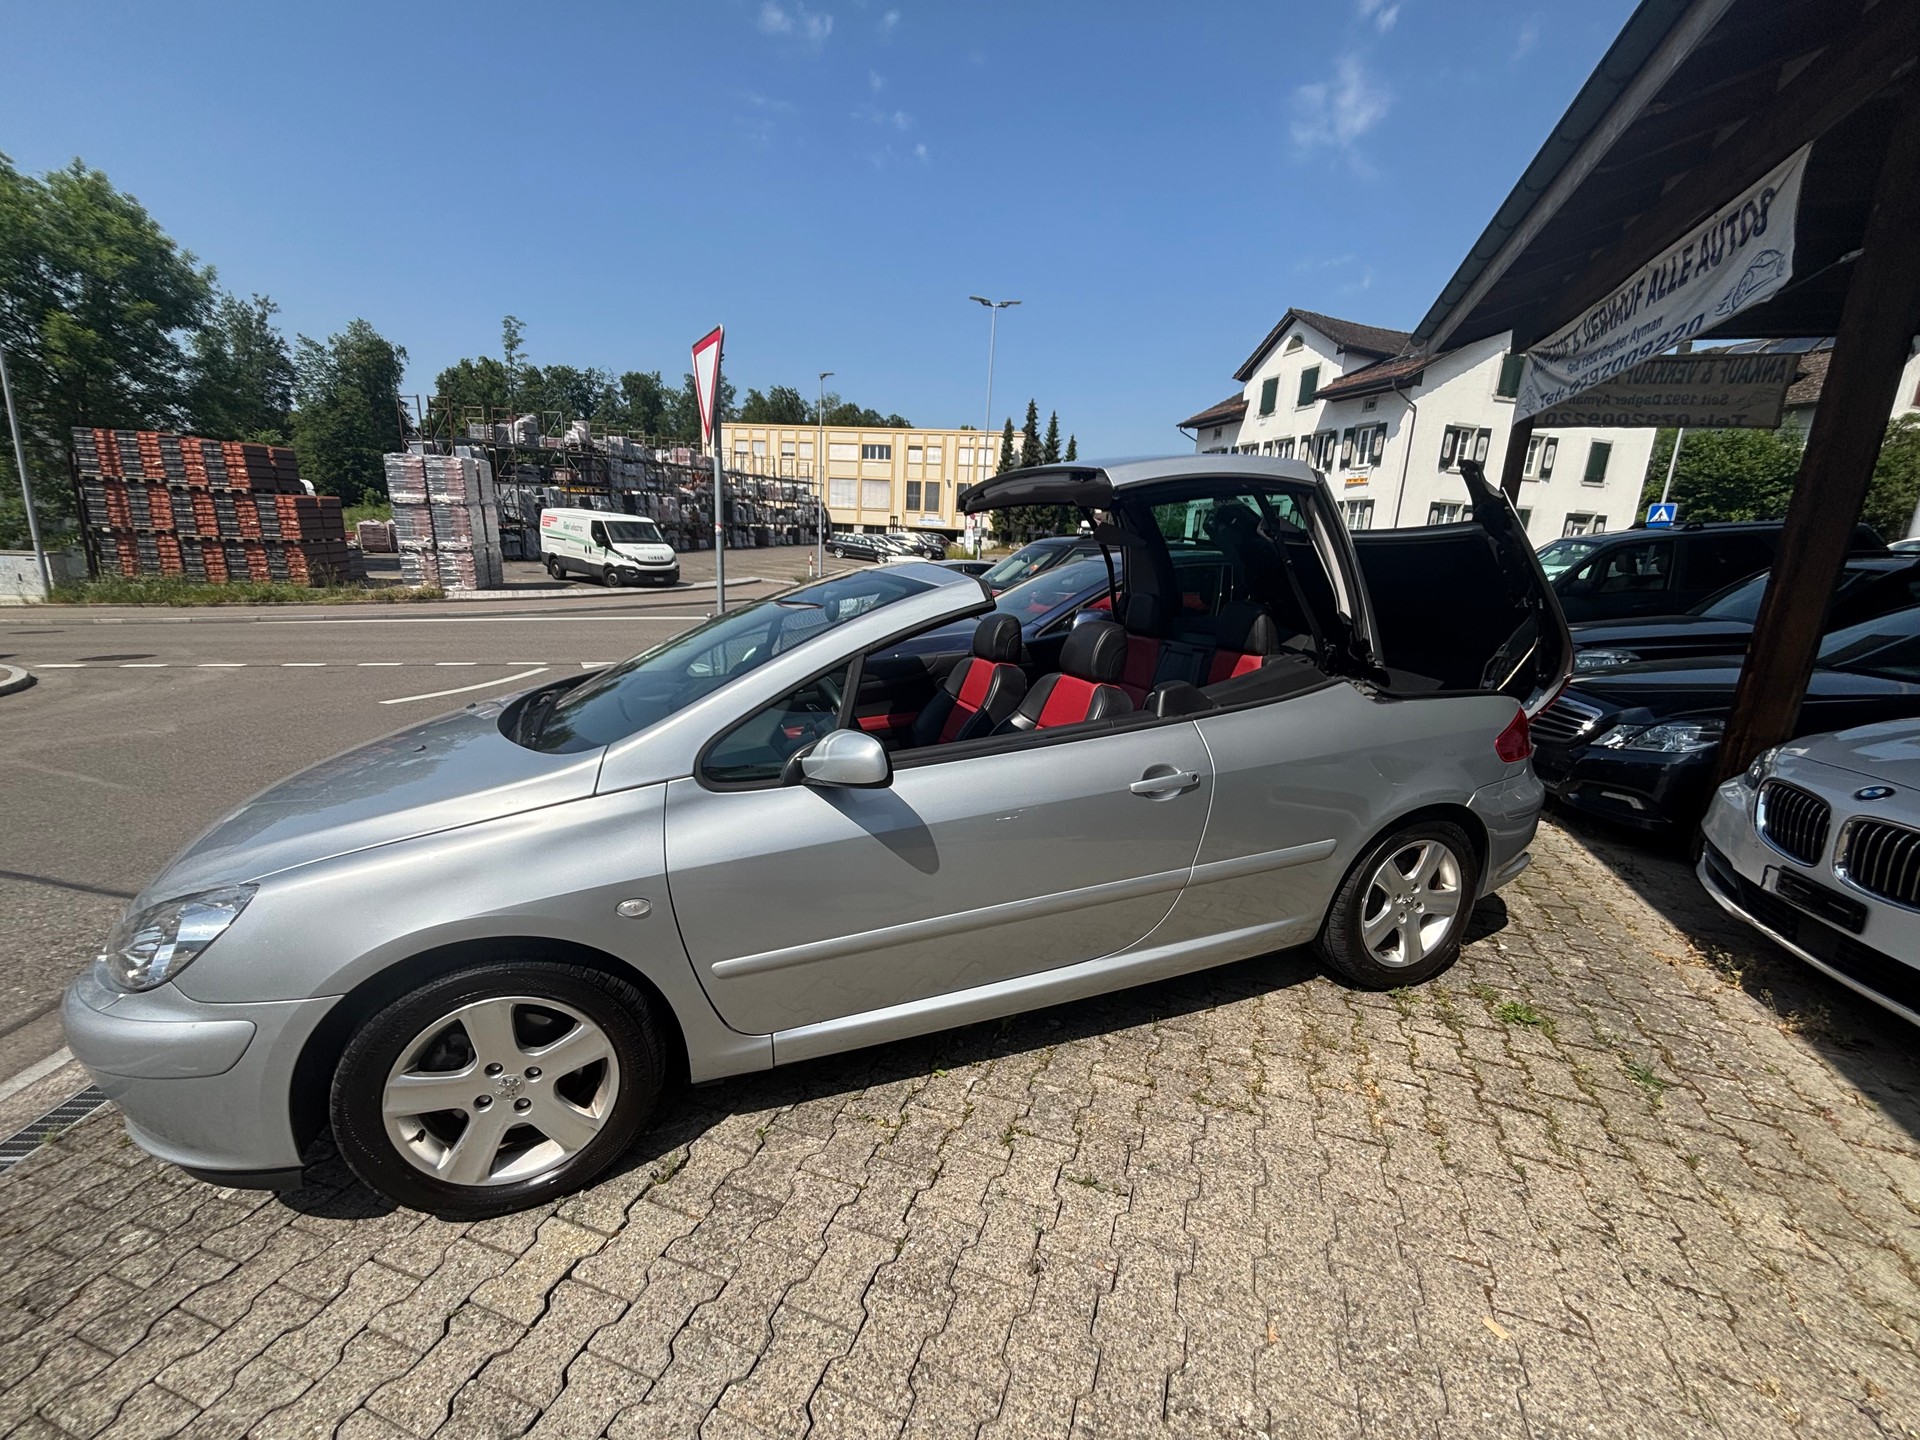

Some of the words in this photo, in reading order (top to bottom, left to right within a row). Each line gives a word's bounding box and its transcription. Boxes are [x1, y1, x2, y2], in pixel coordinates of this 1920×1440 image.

[1583, 277, 1645, 347] VERKAUF
[1645, 244, 1694, 308] ALLE
[1694, 187, 1776, 278] AUTOS
[1569, 313, 1705, 395] 0792009220
[1630, 315, 1664, 344] Ayman
